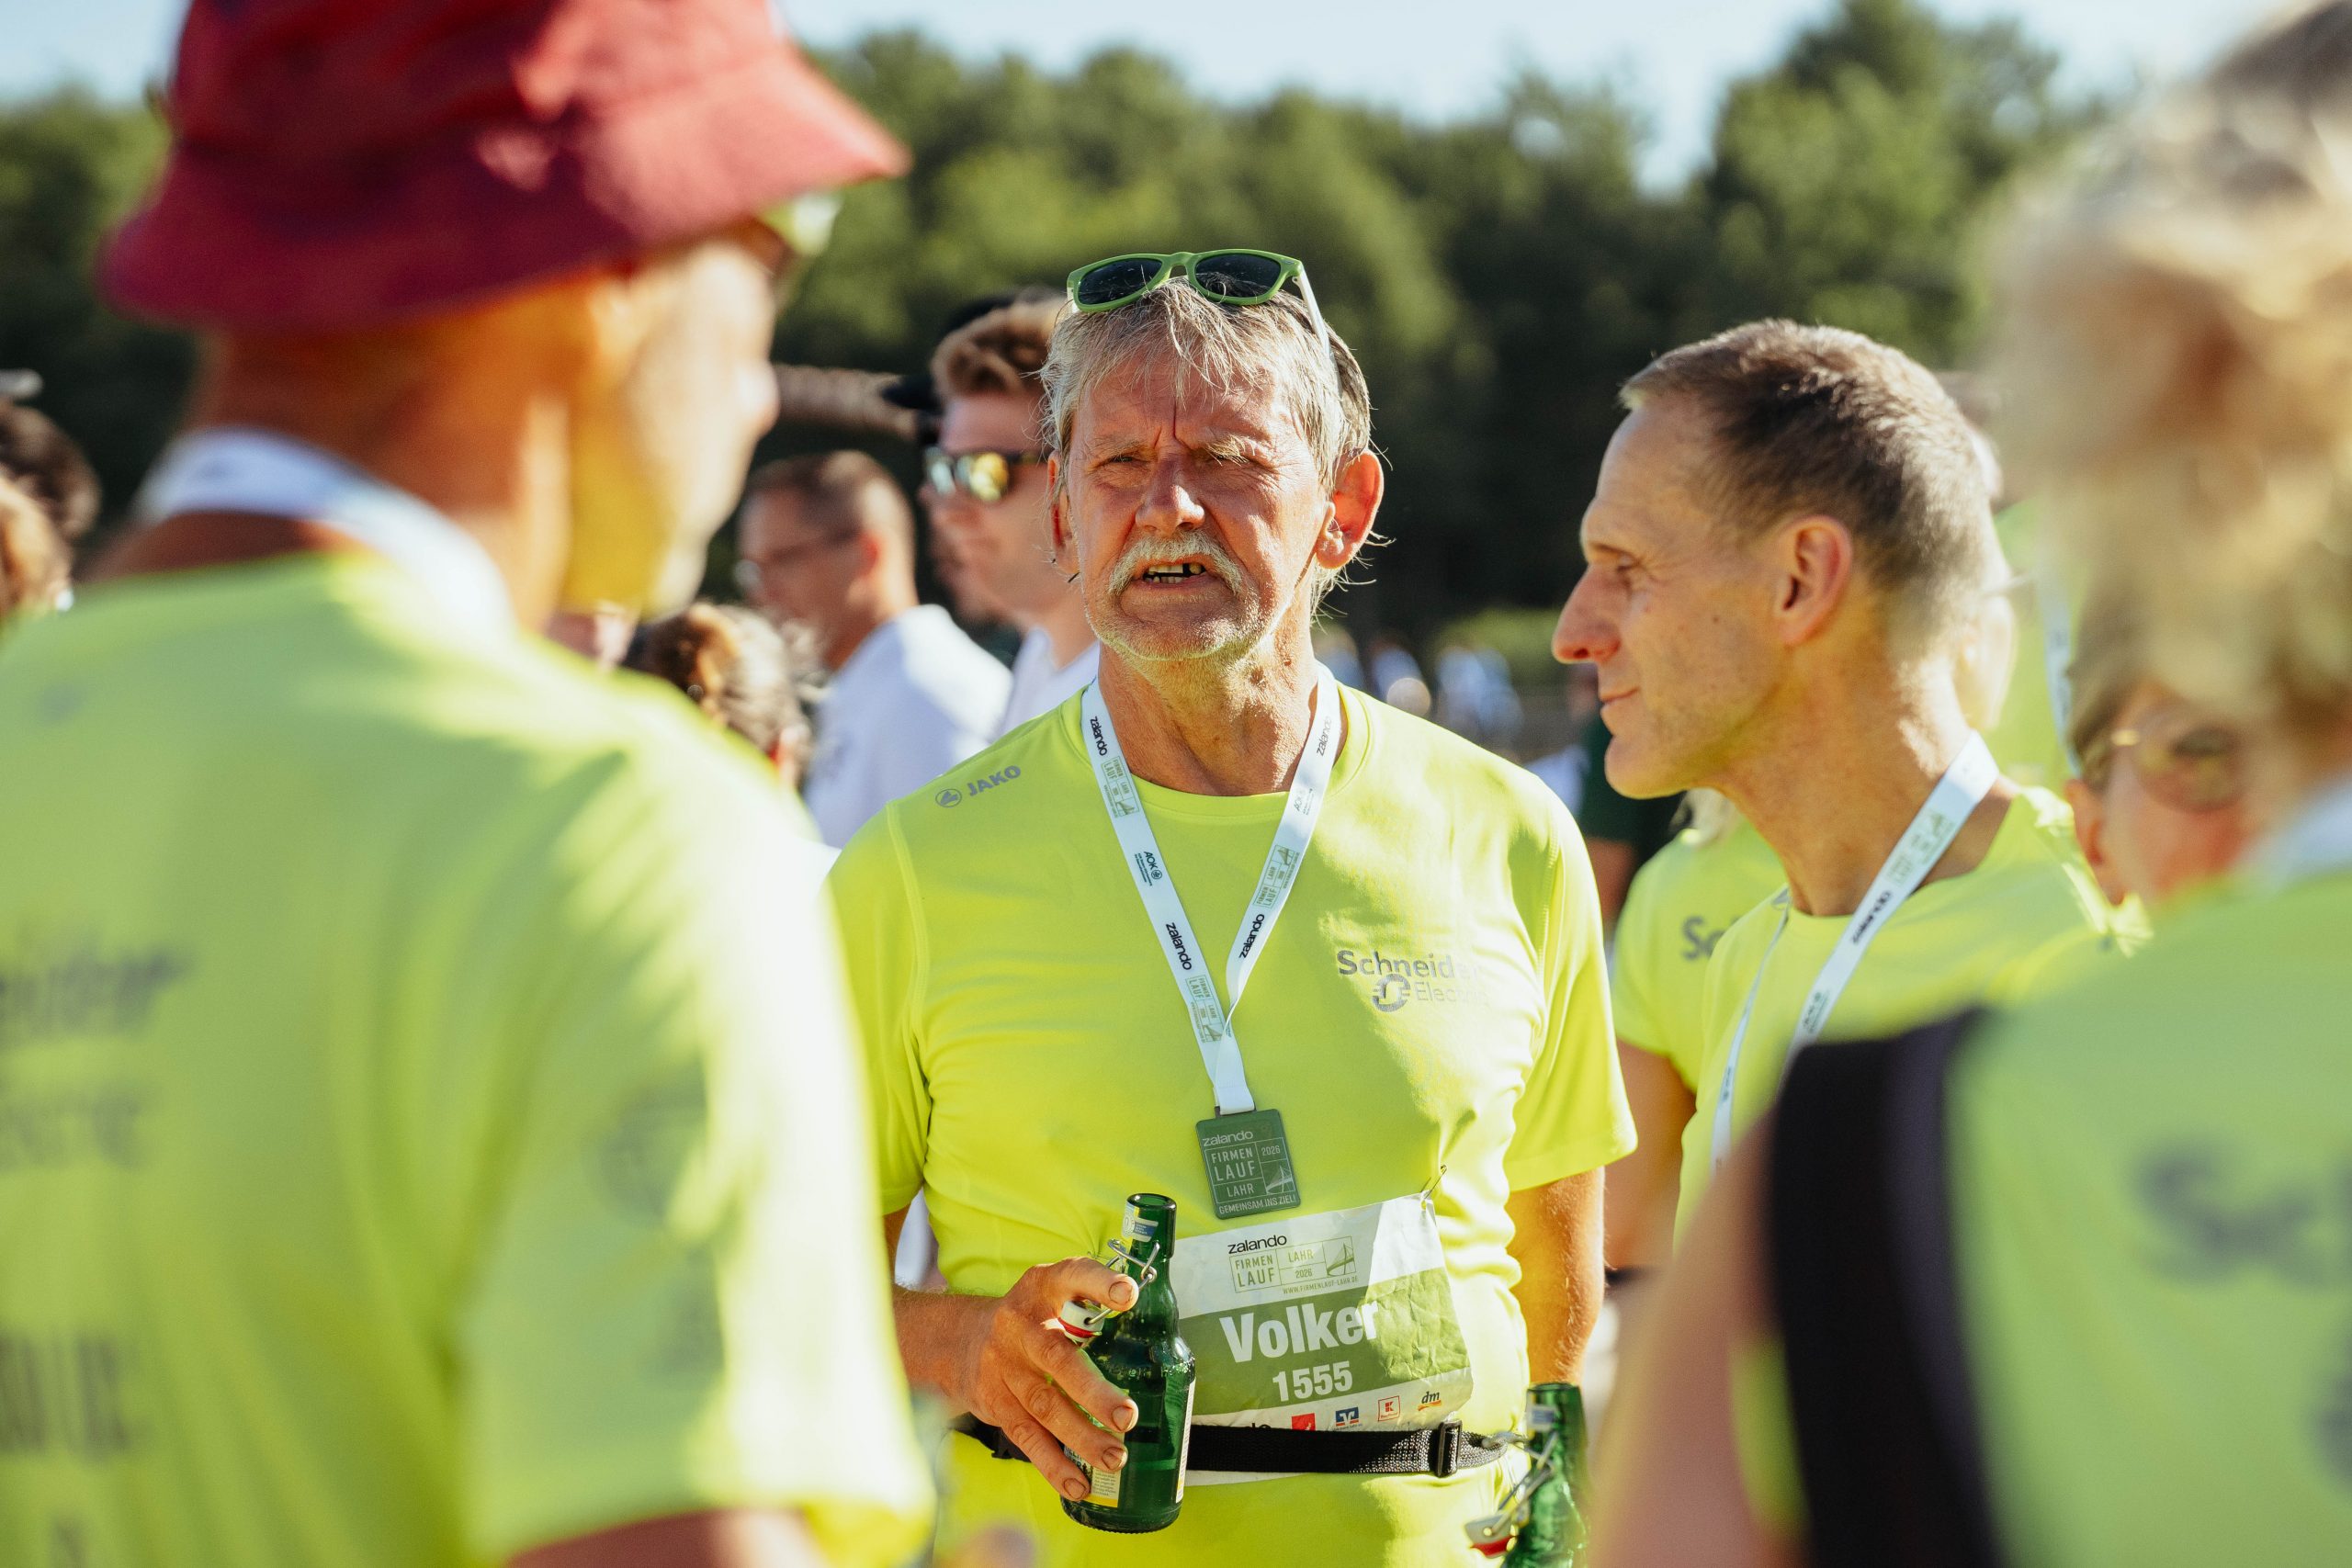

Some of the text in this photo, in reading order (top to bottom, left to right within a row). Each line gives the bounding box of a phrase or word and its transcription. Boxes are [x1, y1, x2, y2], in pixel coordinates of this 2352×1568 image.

[1090, 716, 1108, 756] zalando
[967, 765, 1022, 796] JAKO
[1144, 851, 1159, 870] AOK
[1165, 921, 1193, 971] zalando
[1238, 914, 1265, 959] zalando
[1202, 1131, 1254, 1146] zalando
[1211, 1147, 1253, 1164] FIRMEN
[1261, 1145, 1281, 1156] 2026
[1214, 1160, 1255, 1182] LAUF
[1227, 1183, 1255, 1197] LAHR
[1218, 1194, 1296, 1214] GEMEINSAM INS ZIEL!
[1227, 1235, 1287, 1255] zalando
[1235, 1255, 1273, 1269] FIRMEN
[1288, 1249, 1314, 1263] LAHR
[1237, 1267, 1276, 1288] LAUF
[1295, 1269, 1313, 1279] 2026
[1218, 1300, 1379, 1363] Volker
[1272, 1360, 1353, 1402] 1555
[1421, 1391, 1440, 1404] dm
